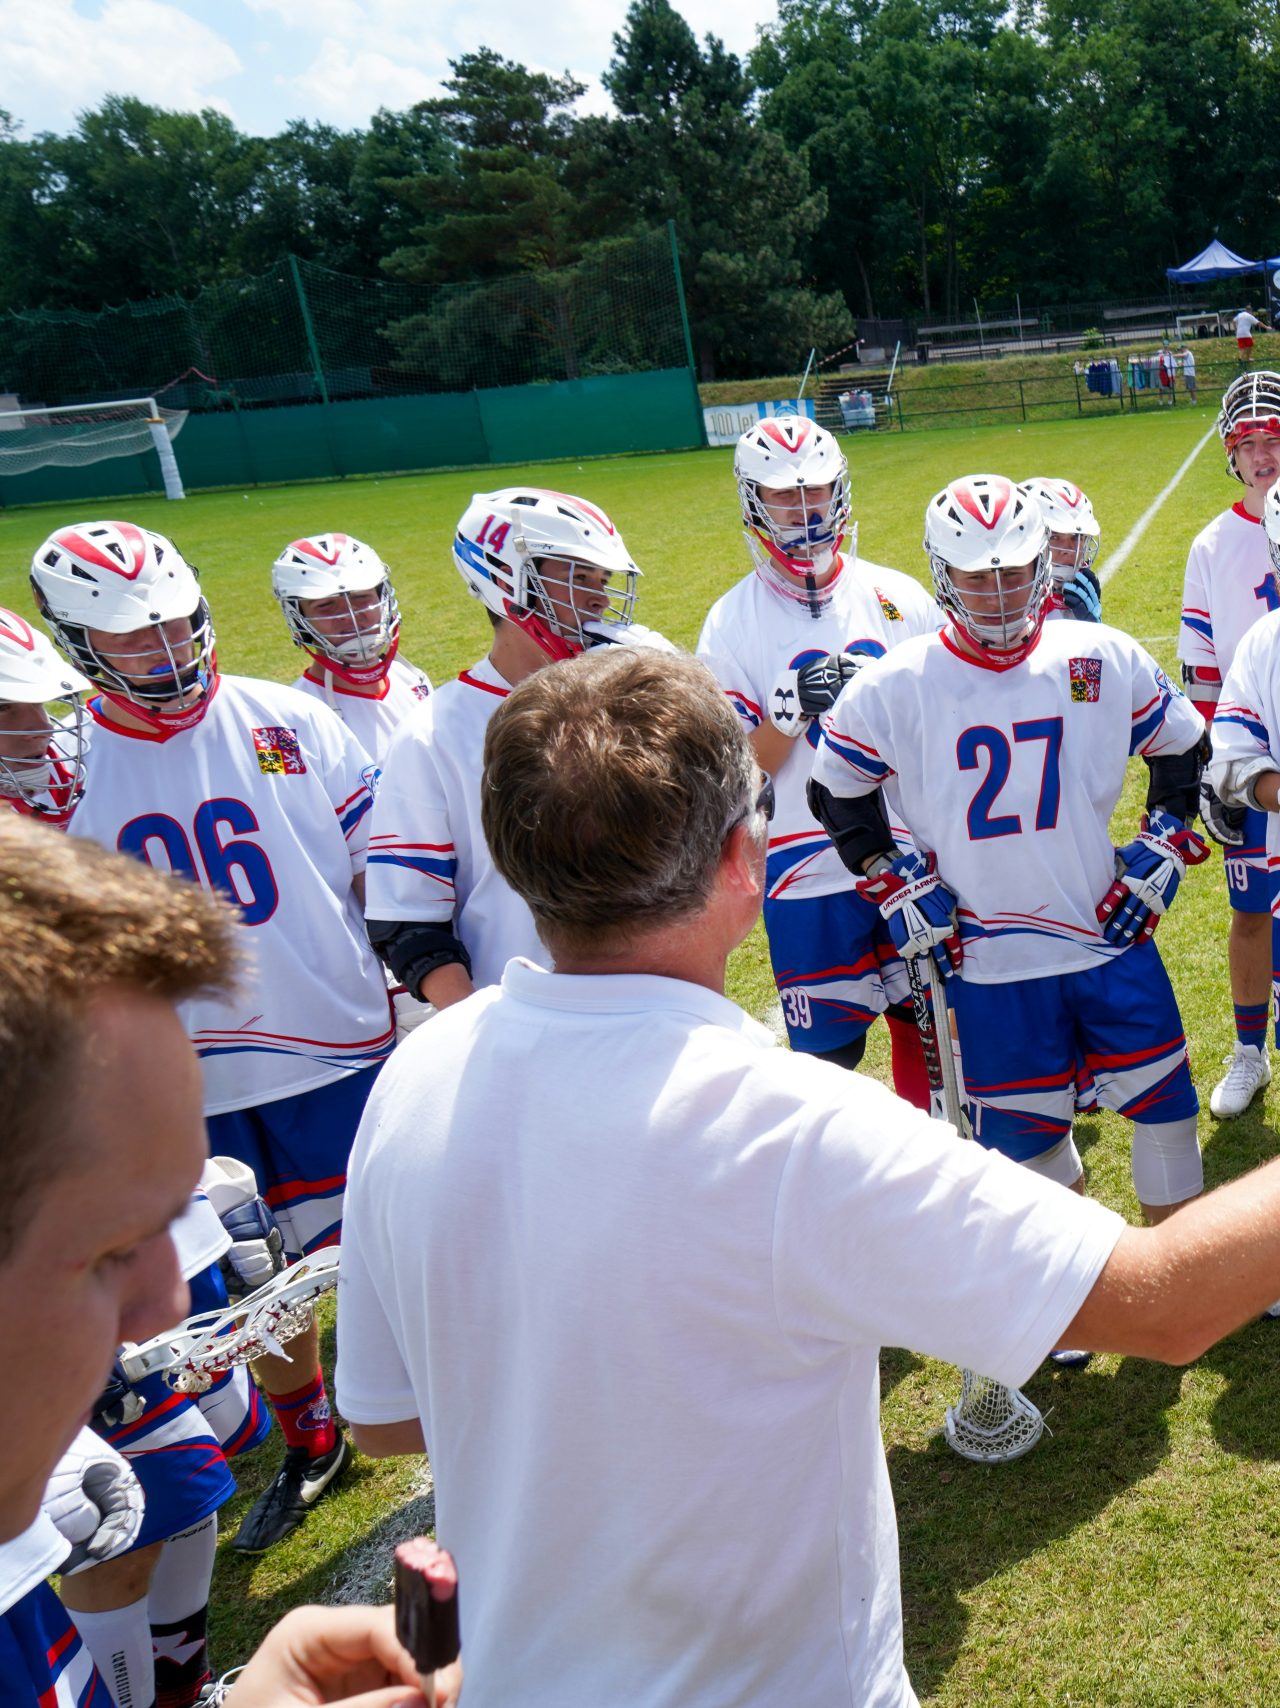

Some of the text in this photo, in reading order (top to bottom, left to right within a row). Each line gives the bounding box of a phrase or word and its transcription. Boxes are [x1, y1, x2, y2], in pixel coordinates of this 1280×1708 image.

[711, 411, 735, 437] 100
[475, 513, 513, 554] 14
[956, 716, 1064, 841] 27
[1136, 833, 1185, 861] DER ARMO
[1224, 857, 1249, 892] 19
[883, 875, 941, 911] UNDER ARMOU
[782, 986, 812, 1030] 39
